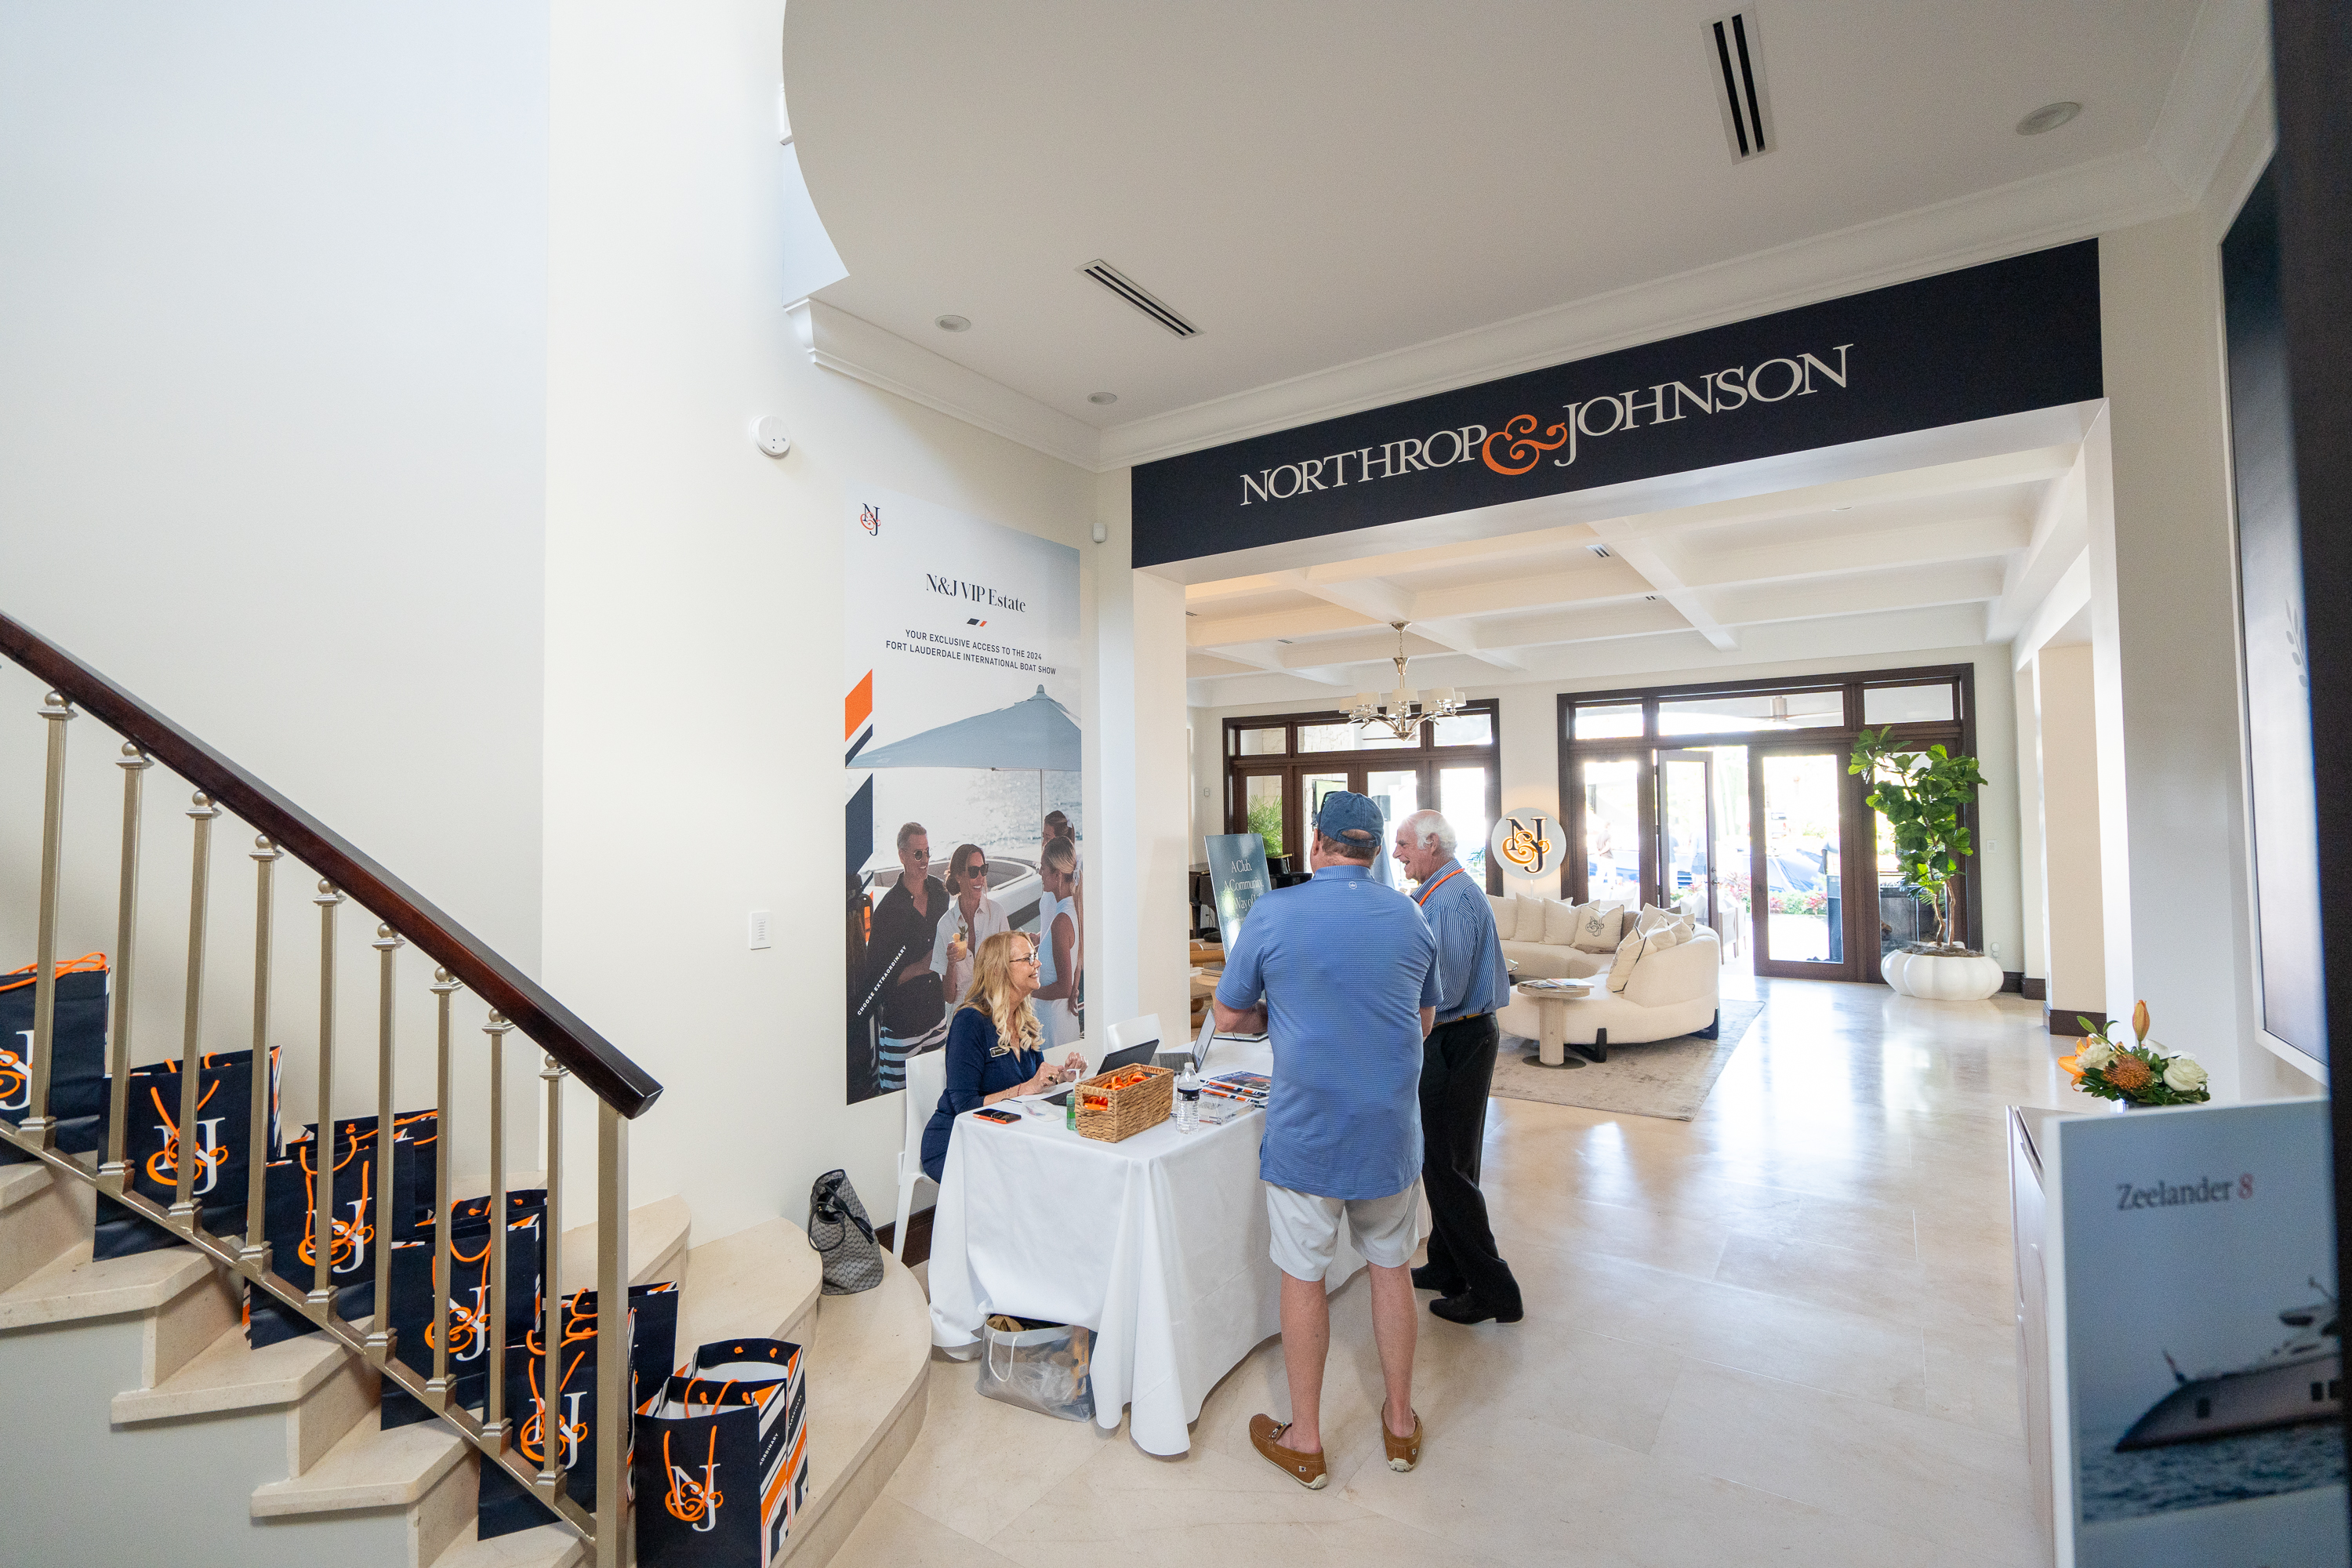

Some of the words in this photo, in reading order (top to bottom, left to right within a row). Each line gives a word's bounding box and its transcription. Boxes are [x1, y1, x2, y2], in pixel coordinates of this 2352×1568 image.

[1240, 424, 1488, 506] NORTHROP
[1554, 343, 1854, 467] JOHNSON
[926, 573, 957, 597] N&J
[960, 582, 985, 602] VIP
[988, 588, 1026, 612] Estate
[886, 641, 907, 651] FORT
[909, 644, 961, 660] LAUDERDALE
[963, 653, 1018, 669] INTERNATIONAL
[1020, 662, 1036, 672] BOAT
[1038, 666, 1056, 675] SHOW
[905, 630, 927, 641] YOUR
[929, 633, 971, 648] EXCLUSIVE
[972, 641, 1000, 653] ACCESS
[1002, 646, 1011, 655] TO
[1012, 648, 1025, 658] THE
[1026, 651, 1042, 660] 2024
[1231, 860, 1237, 873] A
[1236, 858, 1253, 873] Club.
[1229, 877, 1265, 891] Community.
[857, 991, 875, 1015] CHOOSE
[873, 945, 906, 992] EXTRAORDINARY
[2116, 1175, 2233, 1211] Zeelander
[2238, 1173, 2254, 1200] 8
